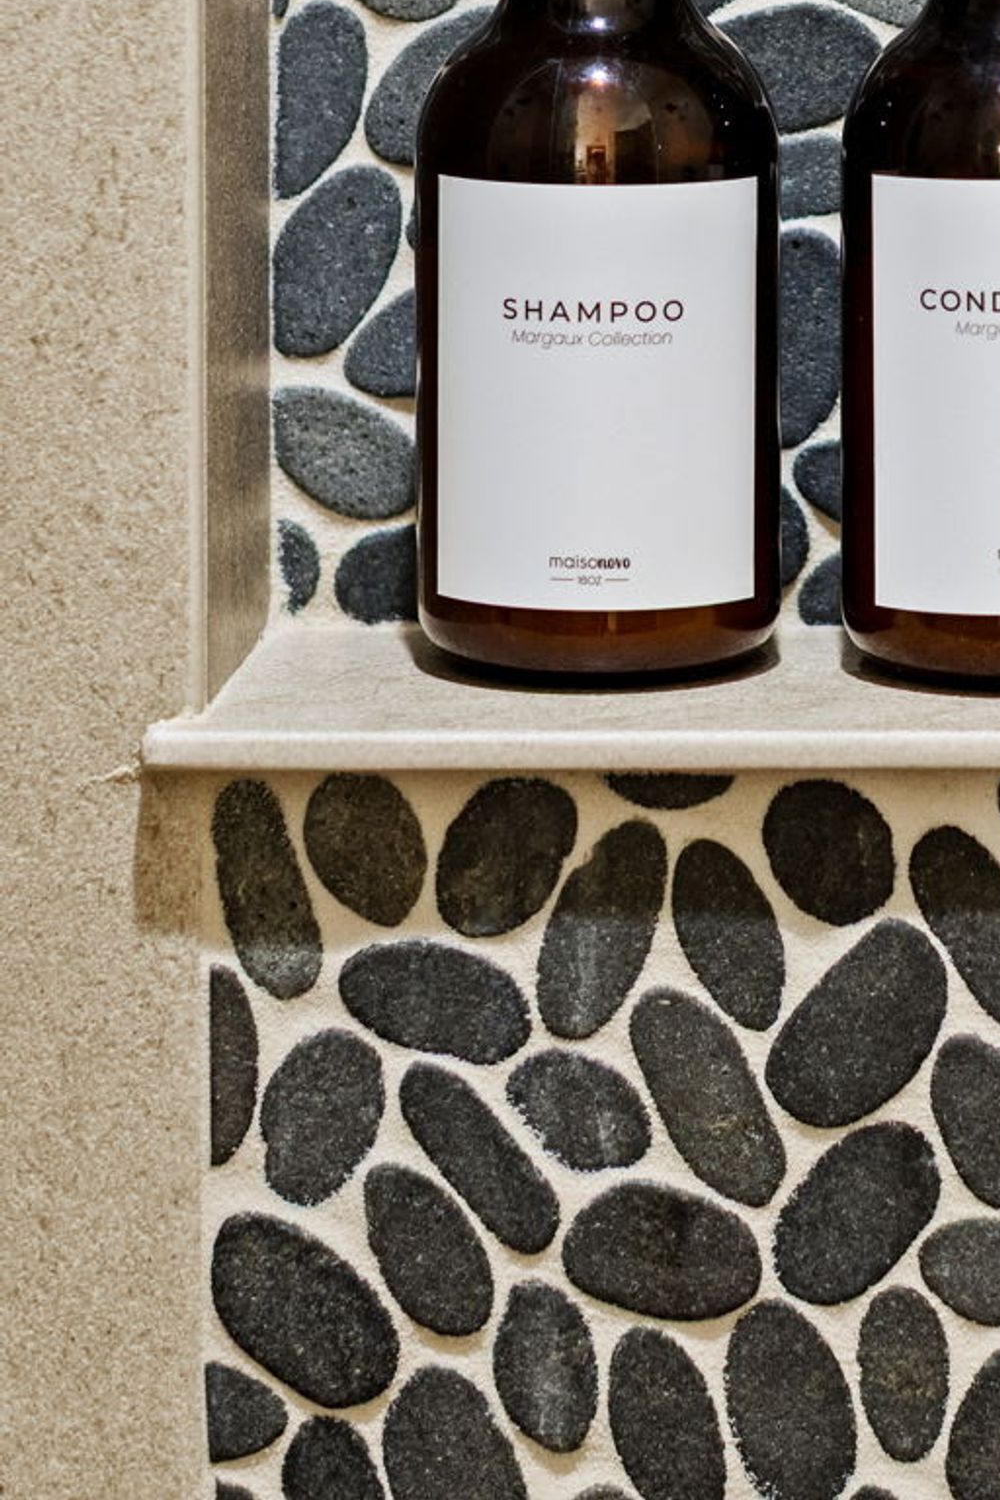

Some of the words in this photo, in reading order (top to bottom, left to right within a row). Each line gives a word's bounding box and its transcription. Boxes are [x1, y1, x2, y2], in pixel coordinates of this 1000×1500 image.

[503, 298, 684, 323] SHAMPOO
[511, 330, 584, 350] Margaux
[588, 330, 673, 347] Collection
